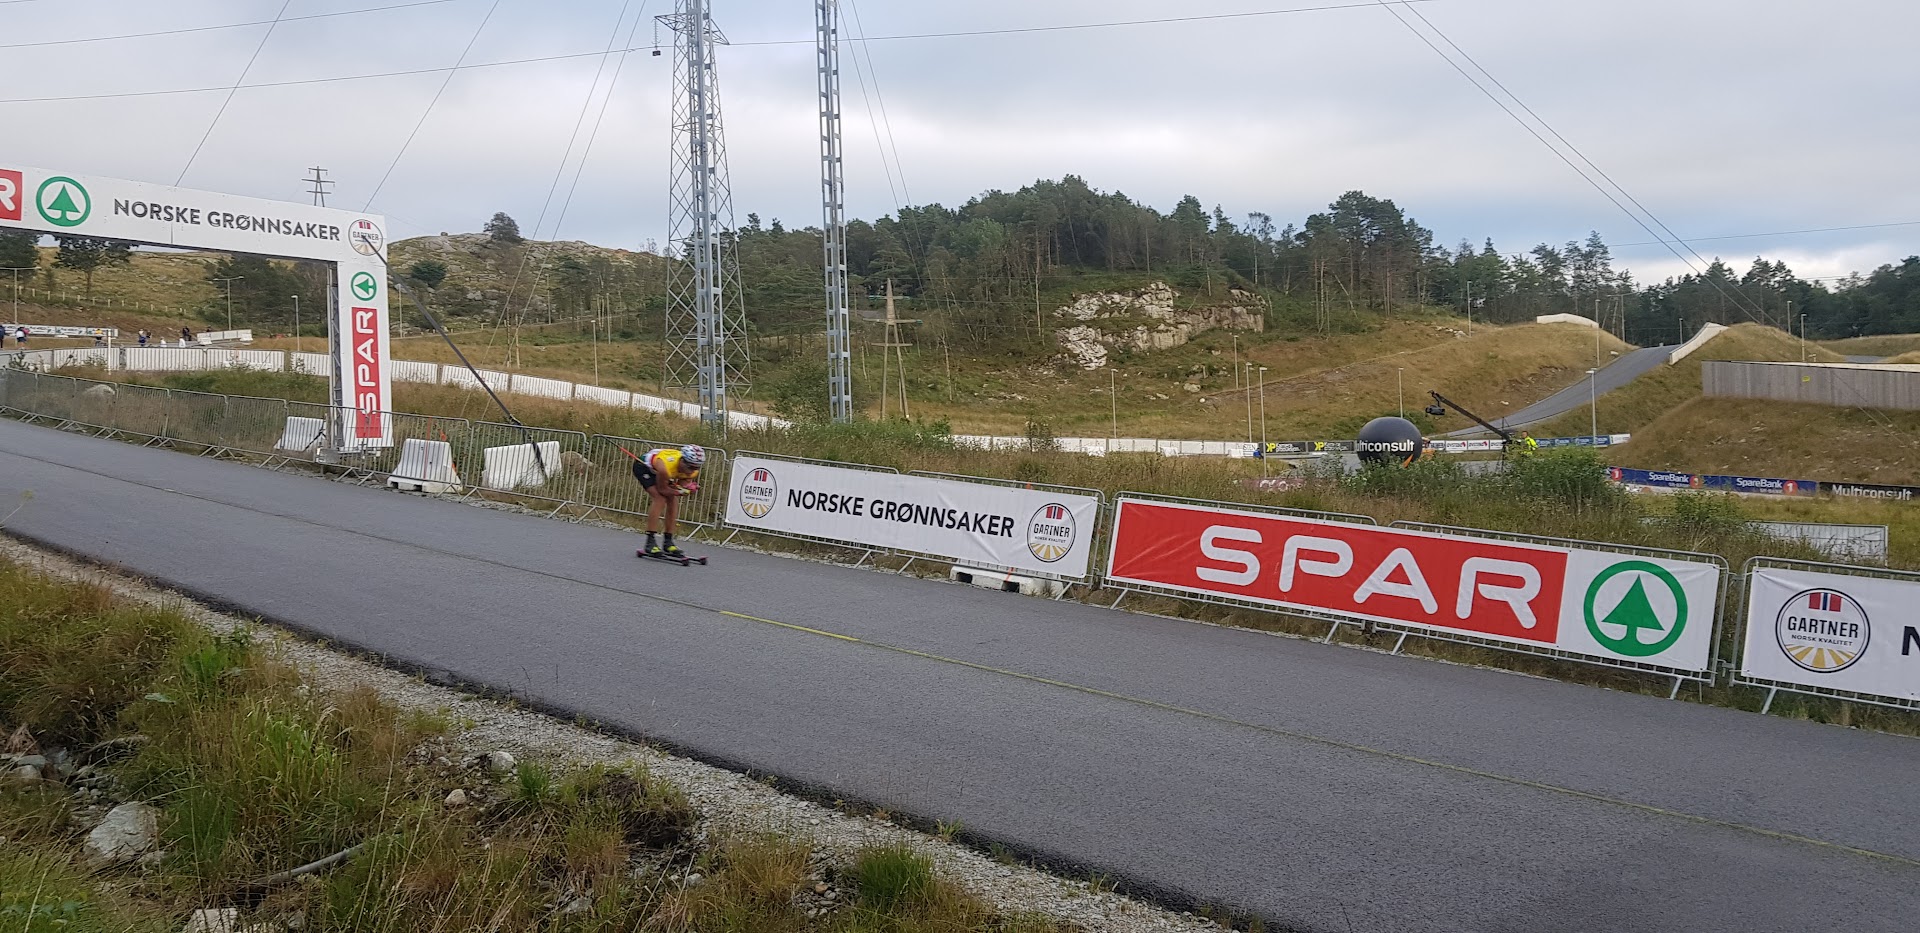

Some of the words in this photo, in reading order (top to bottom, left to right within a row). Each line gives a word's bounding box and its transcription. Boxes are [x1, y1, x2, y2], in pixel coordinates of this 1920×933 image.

[114, 198, 201, 225] NORSKE
[207, 211, 340, 241] GRØNNSAKER
[356, 311, 377, 415] SPAR
[1356, 439, 1415, 452] ulticonsult
[1648, 472, 1689, 483] SpareBank
[1736, 478, 1783, 488] SpareBank
[744, 485, 773, 497] GARTNER
[1832, 484, 1913, 501] Multiconsult
[787, 489, 864, 516] NORSKE
[870, 499, 1015, 538] GRØNNSAKER
[1033, 523, 1070, 538] GARTNER
[1197, 525, 1542, 630] SPAR
[1787, 616, 1859, 639] GARTNER
[1791, 634, 1817, 642] NORSK
[1818, 637, 1853, 647] KVALITET
